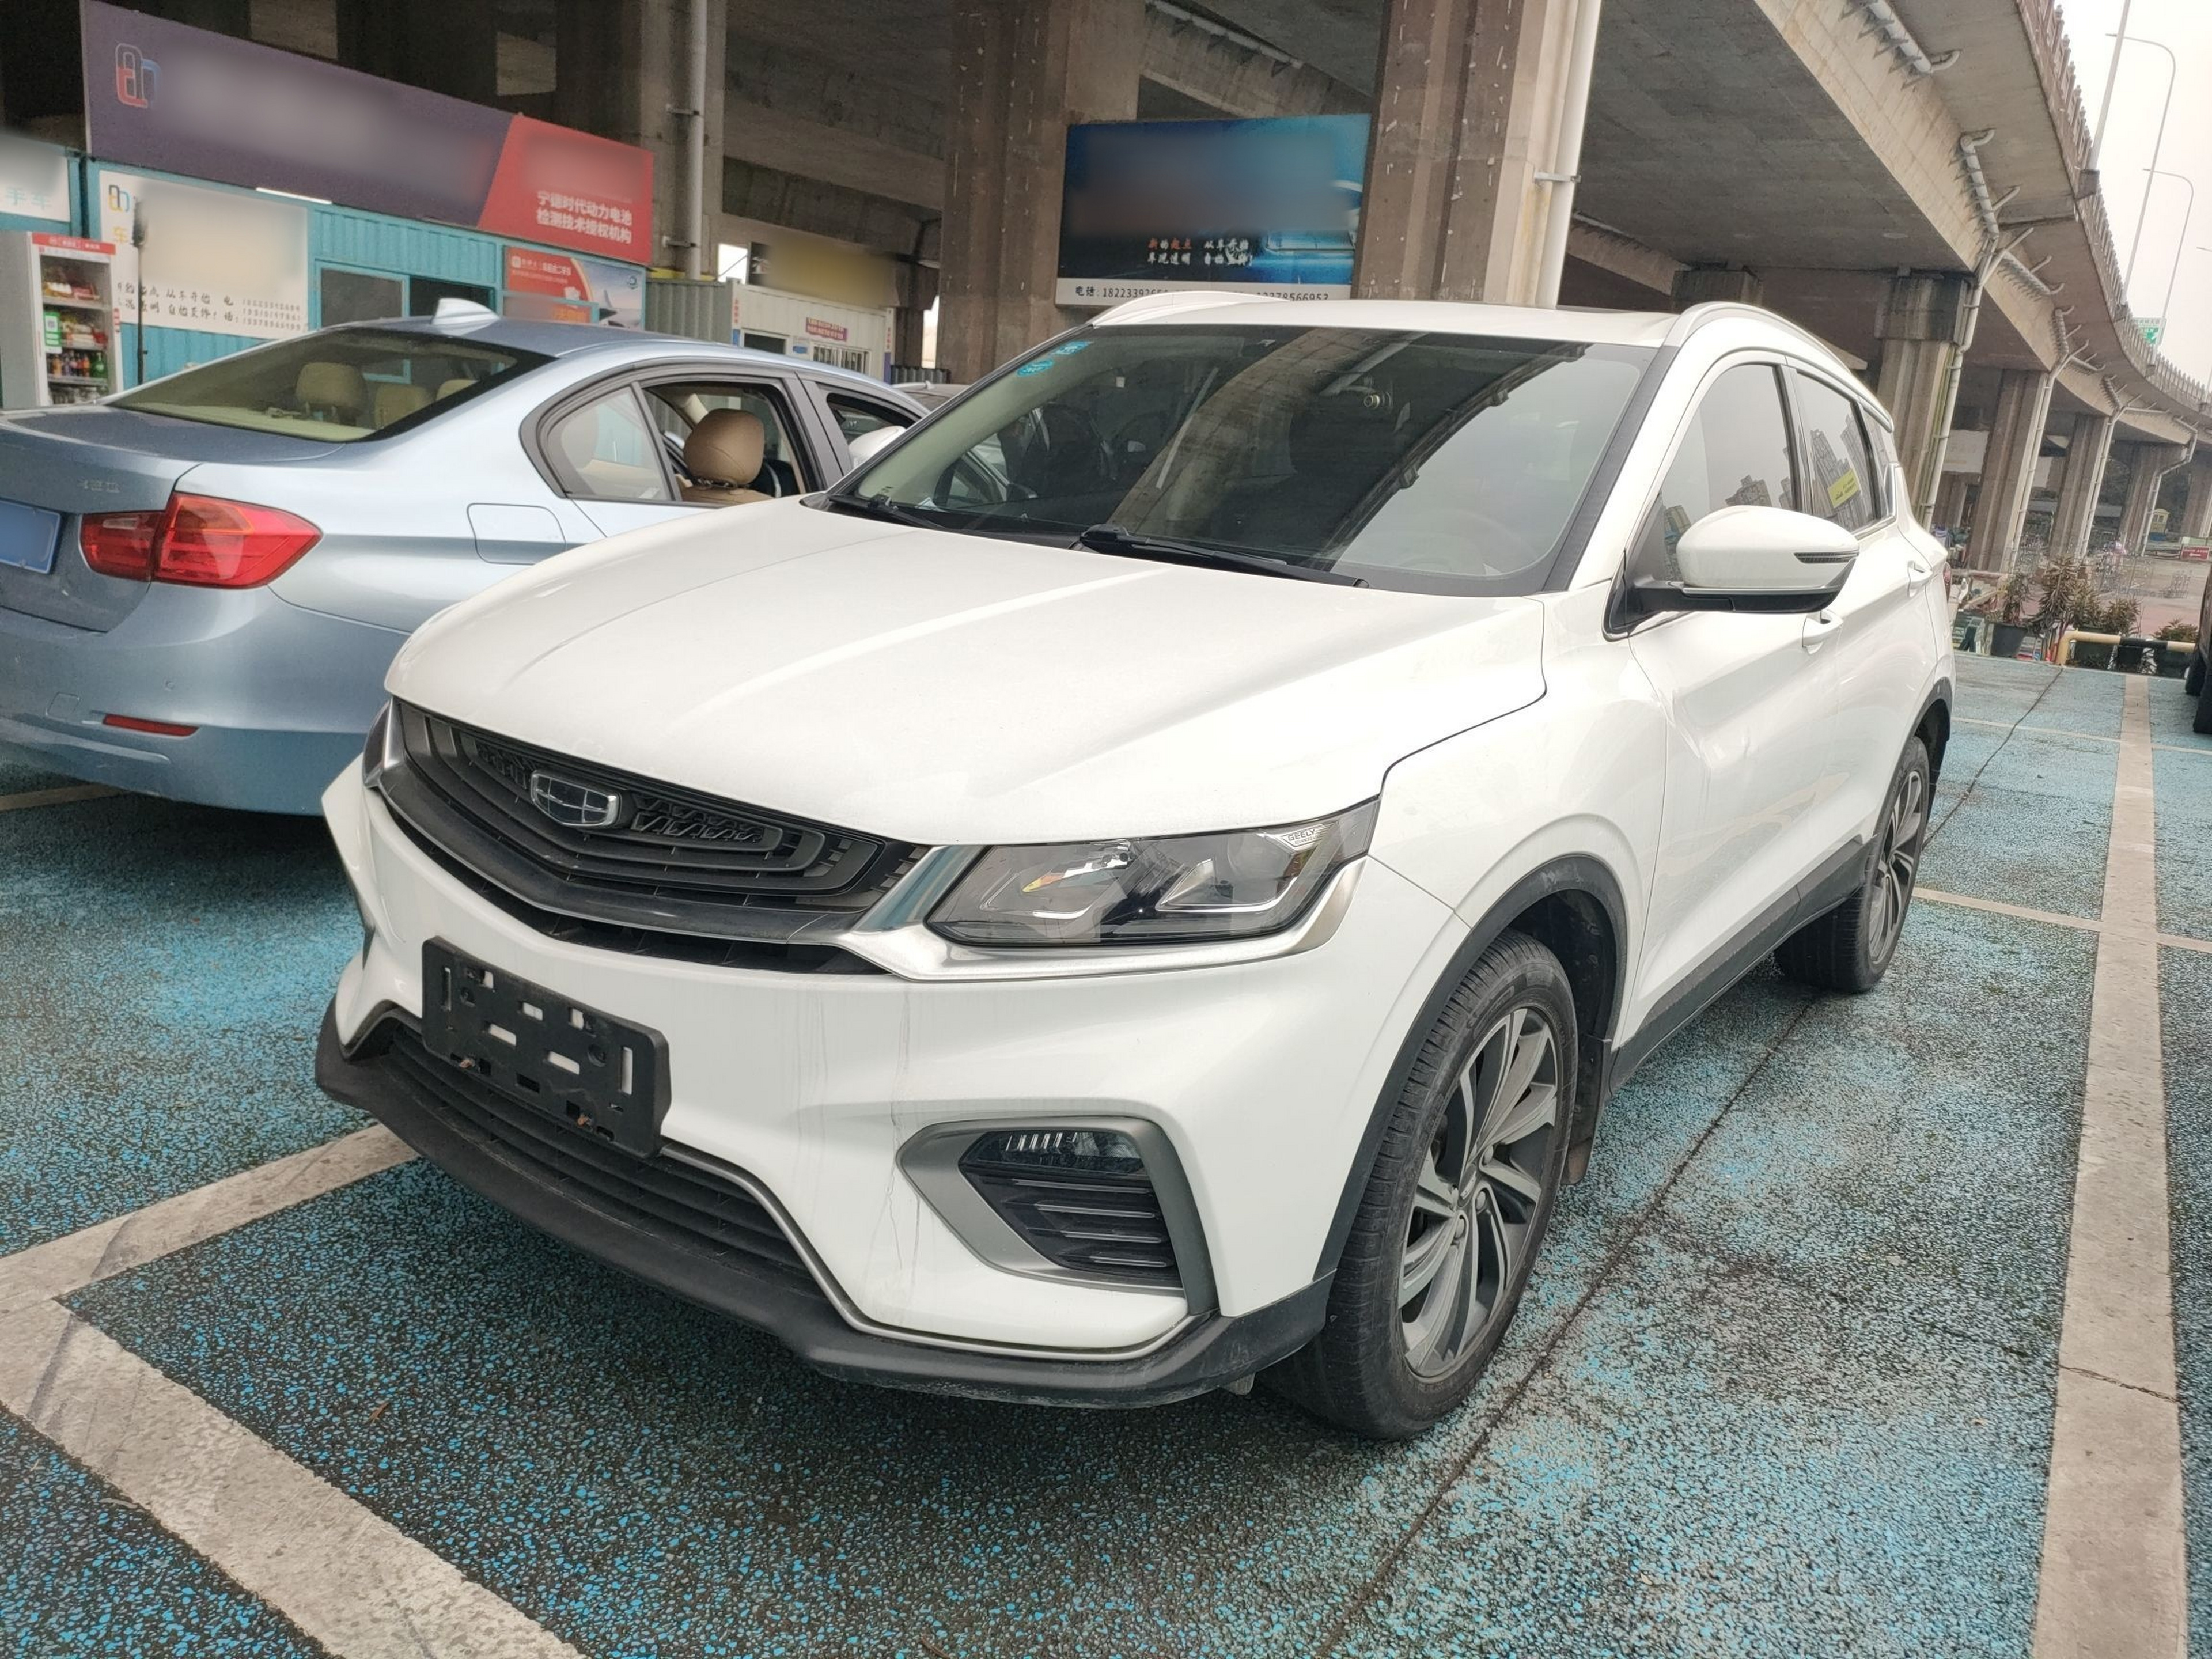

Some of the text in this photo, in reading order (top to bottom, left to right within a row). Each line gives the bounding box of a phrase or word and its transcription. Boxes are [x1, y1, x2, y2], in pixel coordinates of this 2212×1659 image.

[536, 206, 632, 244] 检测技术授权机构
[537, 190, 632, 226] 宁德时代动力电池
[1287, 829, 1316, 841] GEELY
